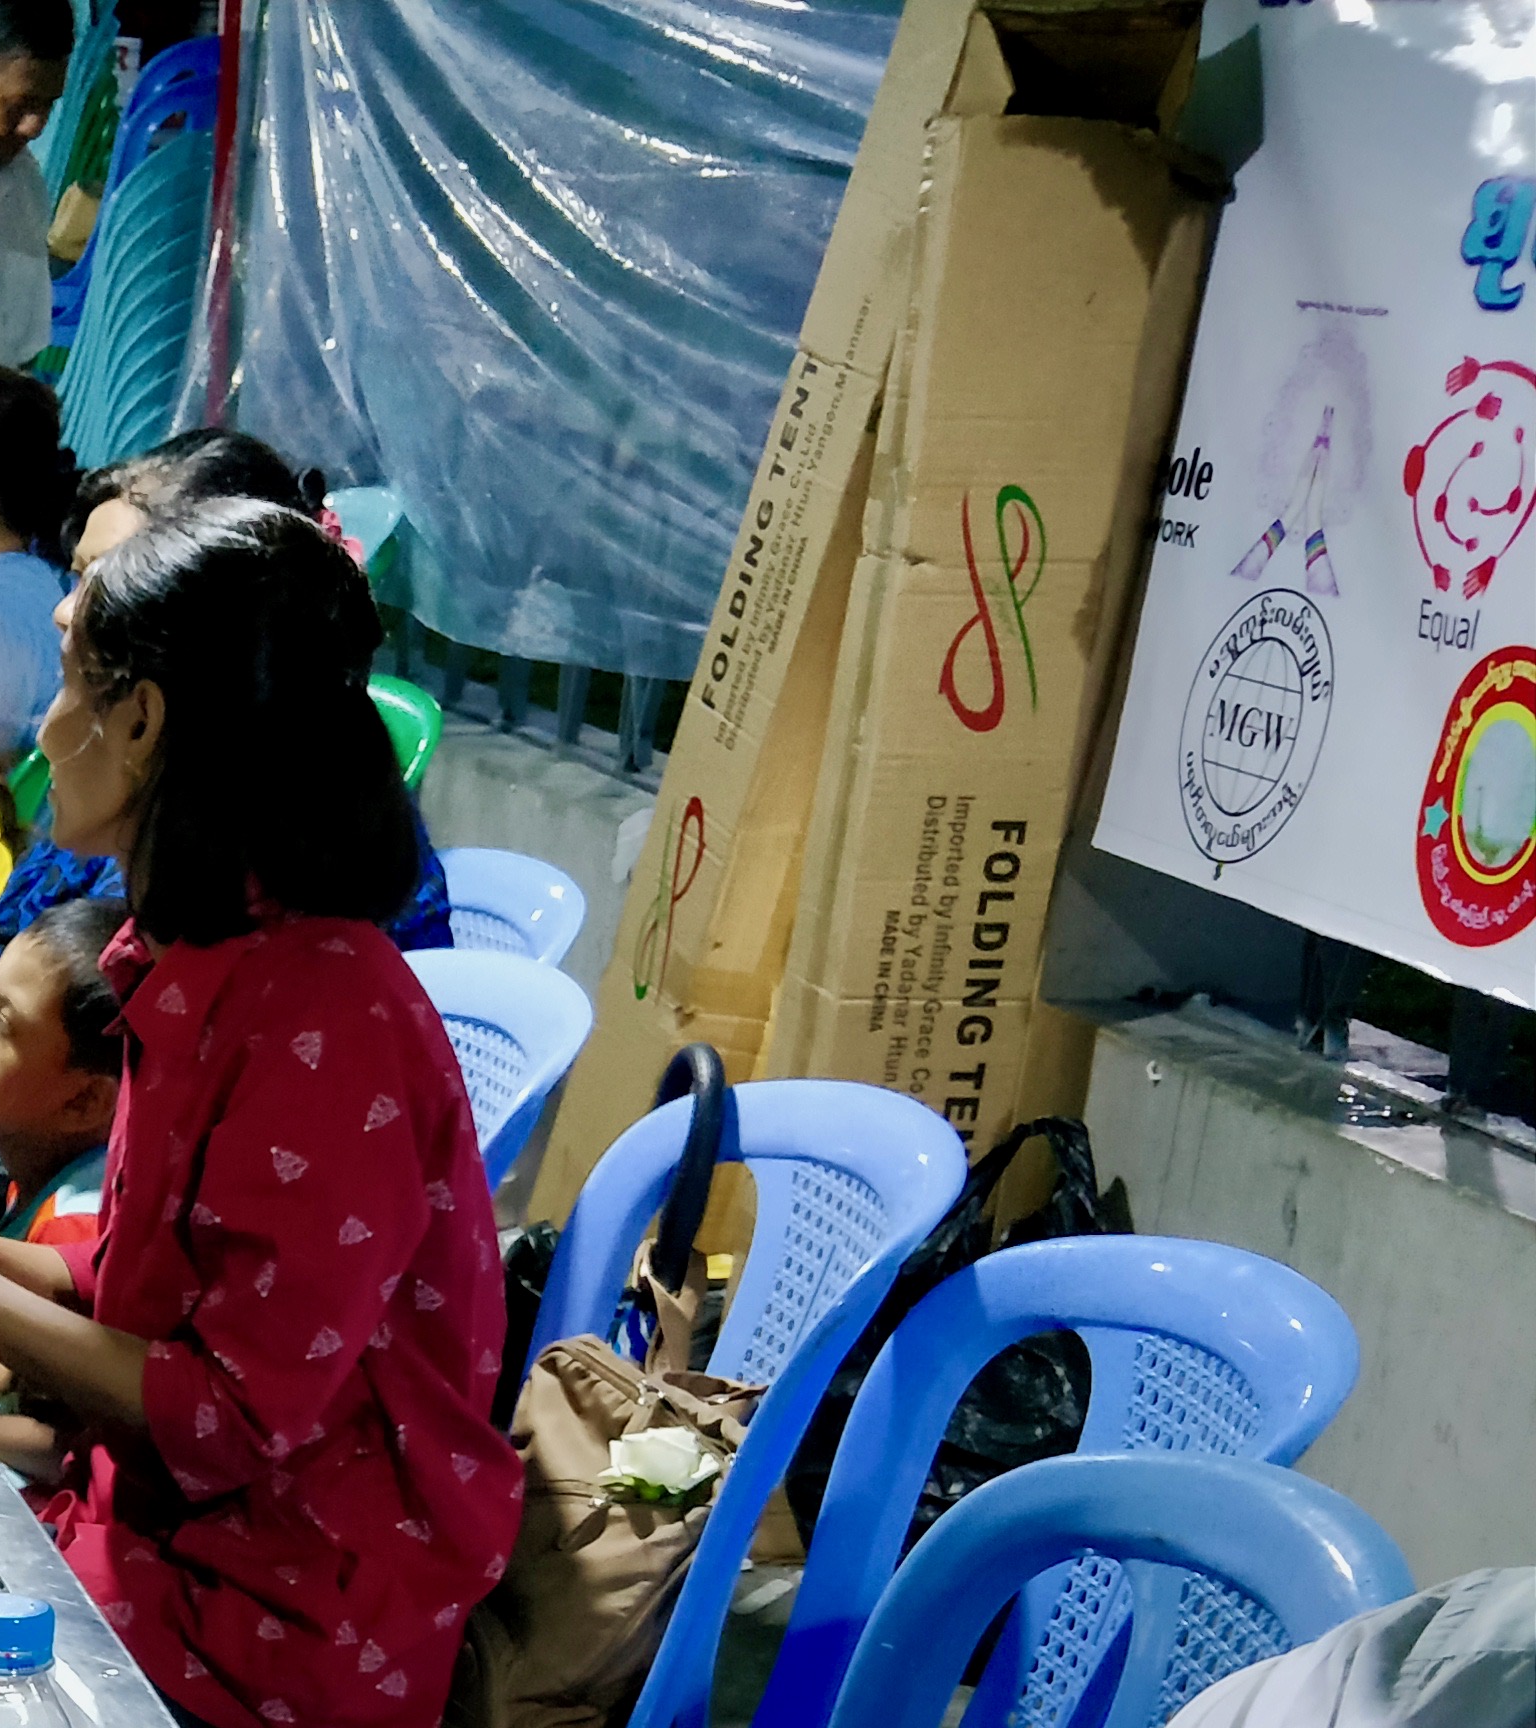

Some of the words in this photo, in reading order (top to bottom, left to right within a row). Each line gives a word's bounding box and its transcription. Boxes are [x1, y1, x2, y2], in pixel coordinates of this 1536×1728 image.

[699, 498, 777, 710] FOLDING
[767, 352, 821, 484] TENT
[769, 497, 795, 556] Grace
[786, 535, 808, 585] CHINA
[747, 561, 777, 627] Infinity
[757, 621, 772, 645] by
[766, 536, 799, 616] Yadanar
[780, 588, 793, 608] IN
[739, 631, 756, 655] by
[767, 609, 787, 655] MADE
[1418, 598, 1480, 652] Equal
[1210, 698, 1294, 753] MGW
[912, 796, 947, 905] Distributed
[942, 795, 975, 887] Imported
[879, 910, 900, 956] MADE
[903, 914, 927, 938] by
[934, 896, 958, 919] by
[957, 821, 1027, 1043] FOLDING
[876, 962, 893, 978] IN
[921, 924, 953, 993] Infinity
[869, 982, 891, 1032] CHINA
[892, 946, 923, 1026] Yadanar
[915, 999, 941, 1058] Grace
[882, 1037, 906, 1081] Htun
